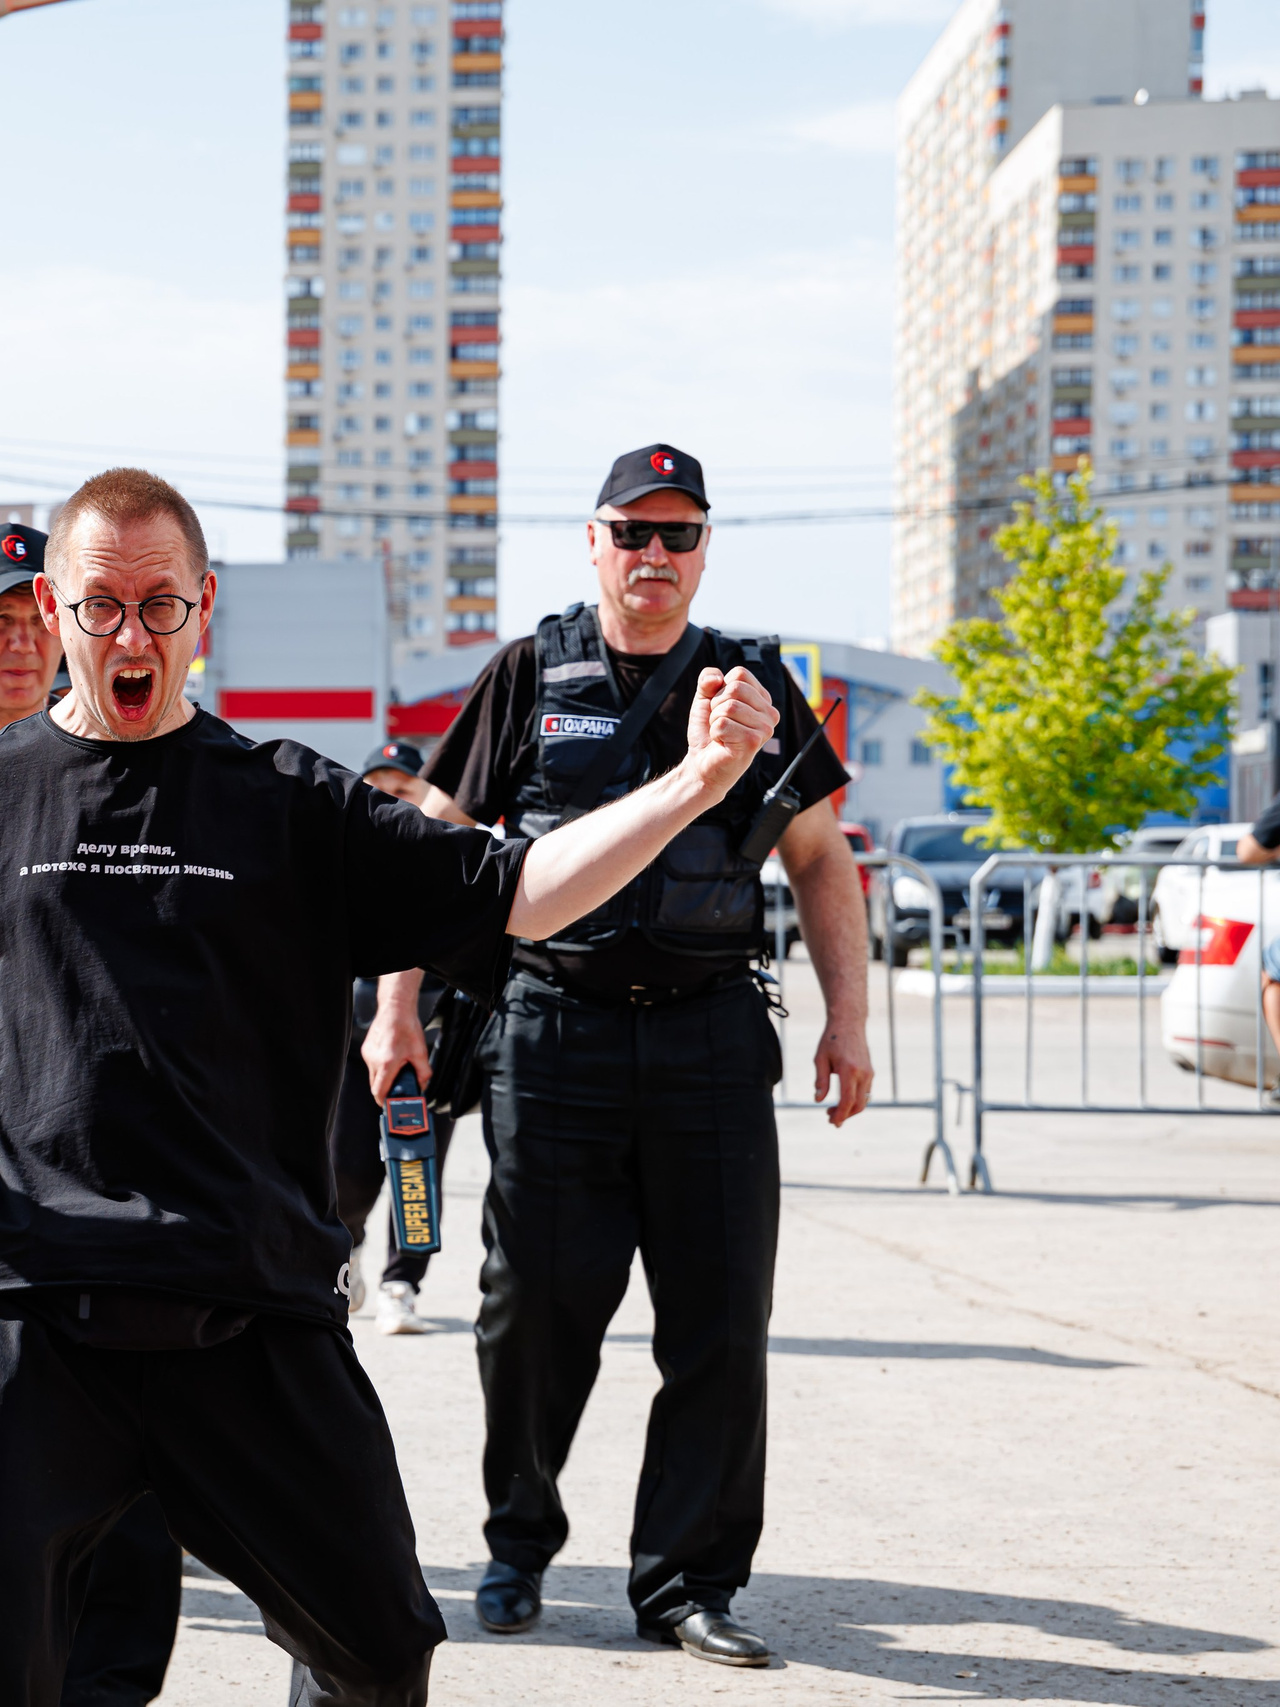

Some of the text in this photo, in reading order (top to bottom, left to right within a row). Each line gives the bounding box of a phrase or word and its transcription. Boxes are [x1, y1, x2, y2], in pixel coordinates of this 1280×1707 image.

[564, 718, 615, 735] ОХРАНА
[76, 842, 176, 857] делу время,
[19, 861, 235, 881] а потехе я посвятил жизнь
[403, 1202, 431, 1244] SUPER
